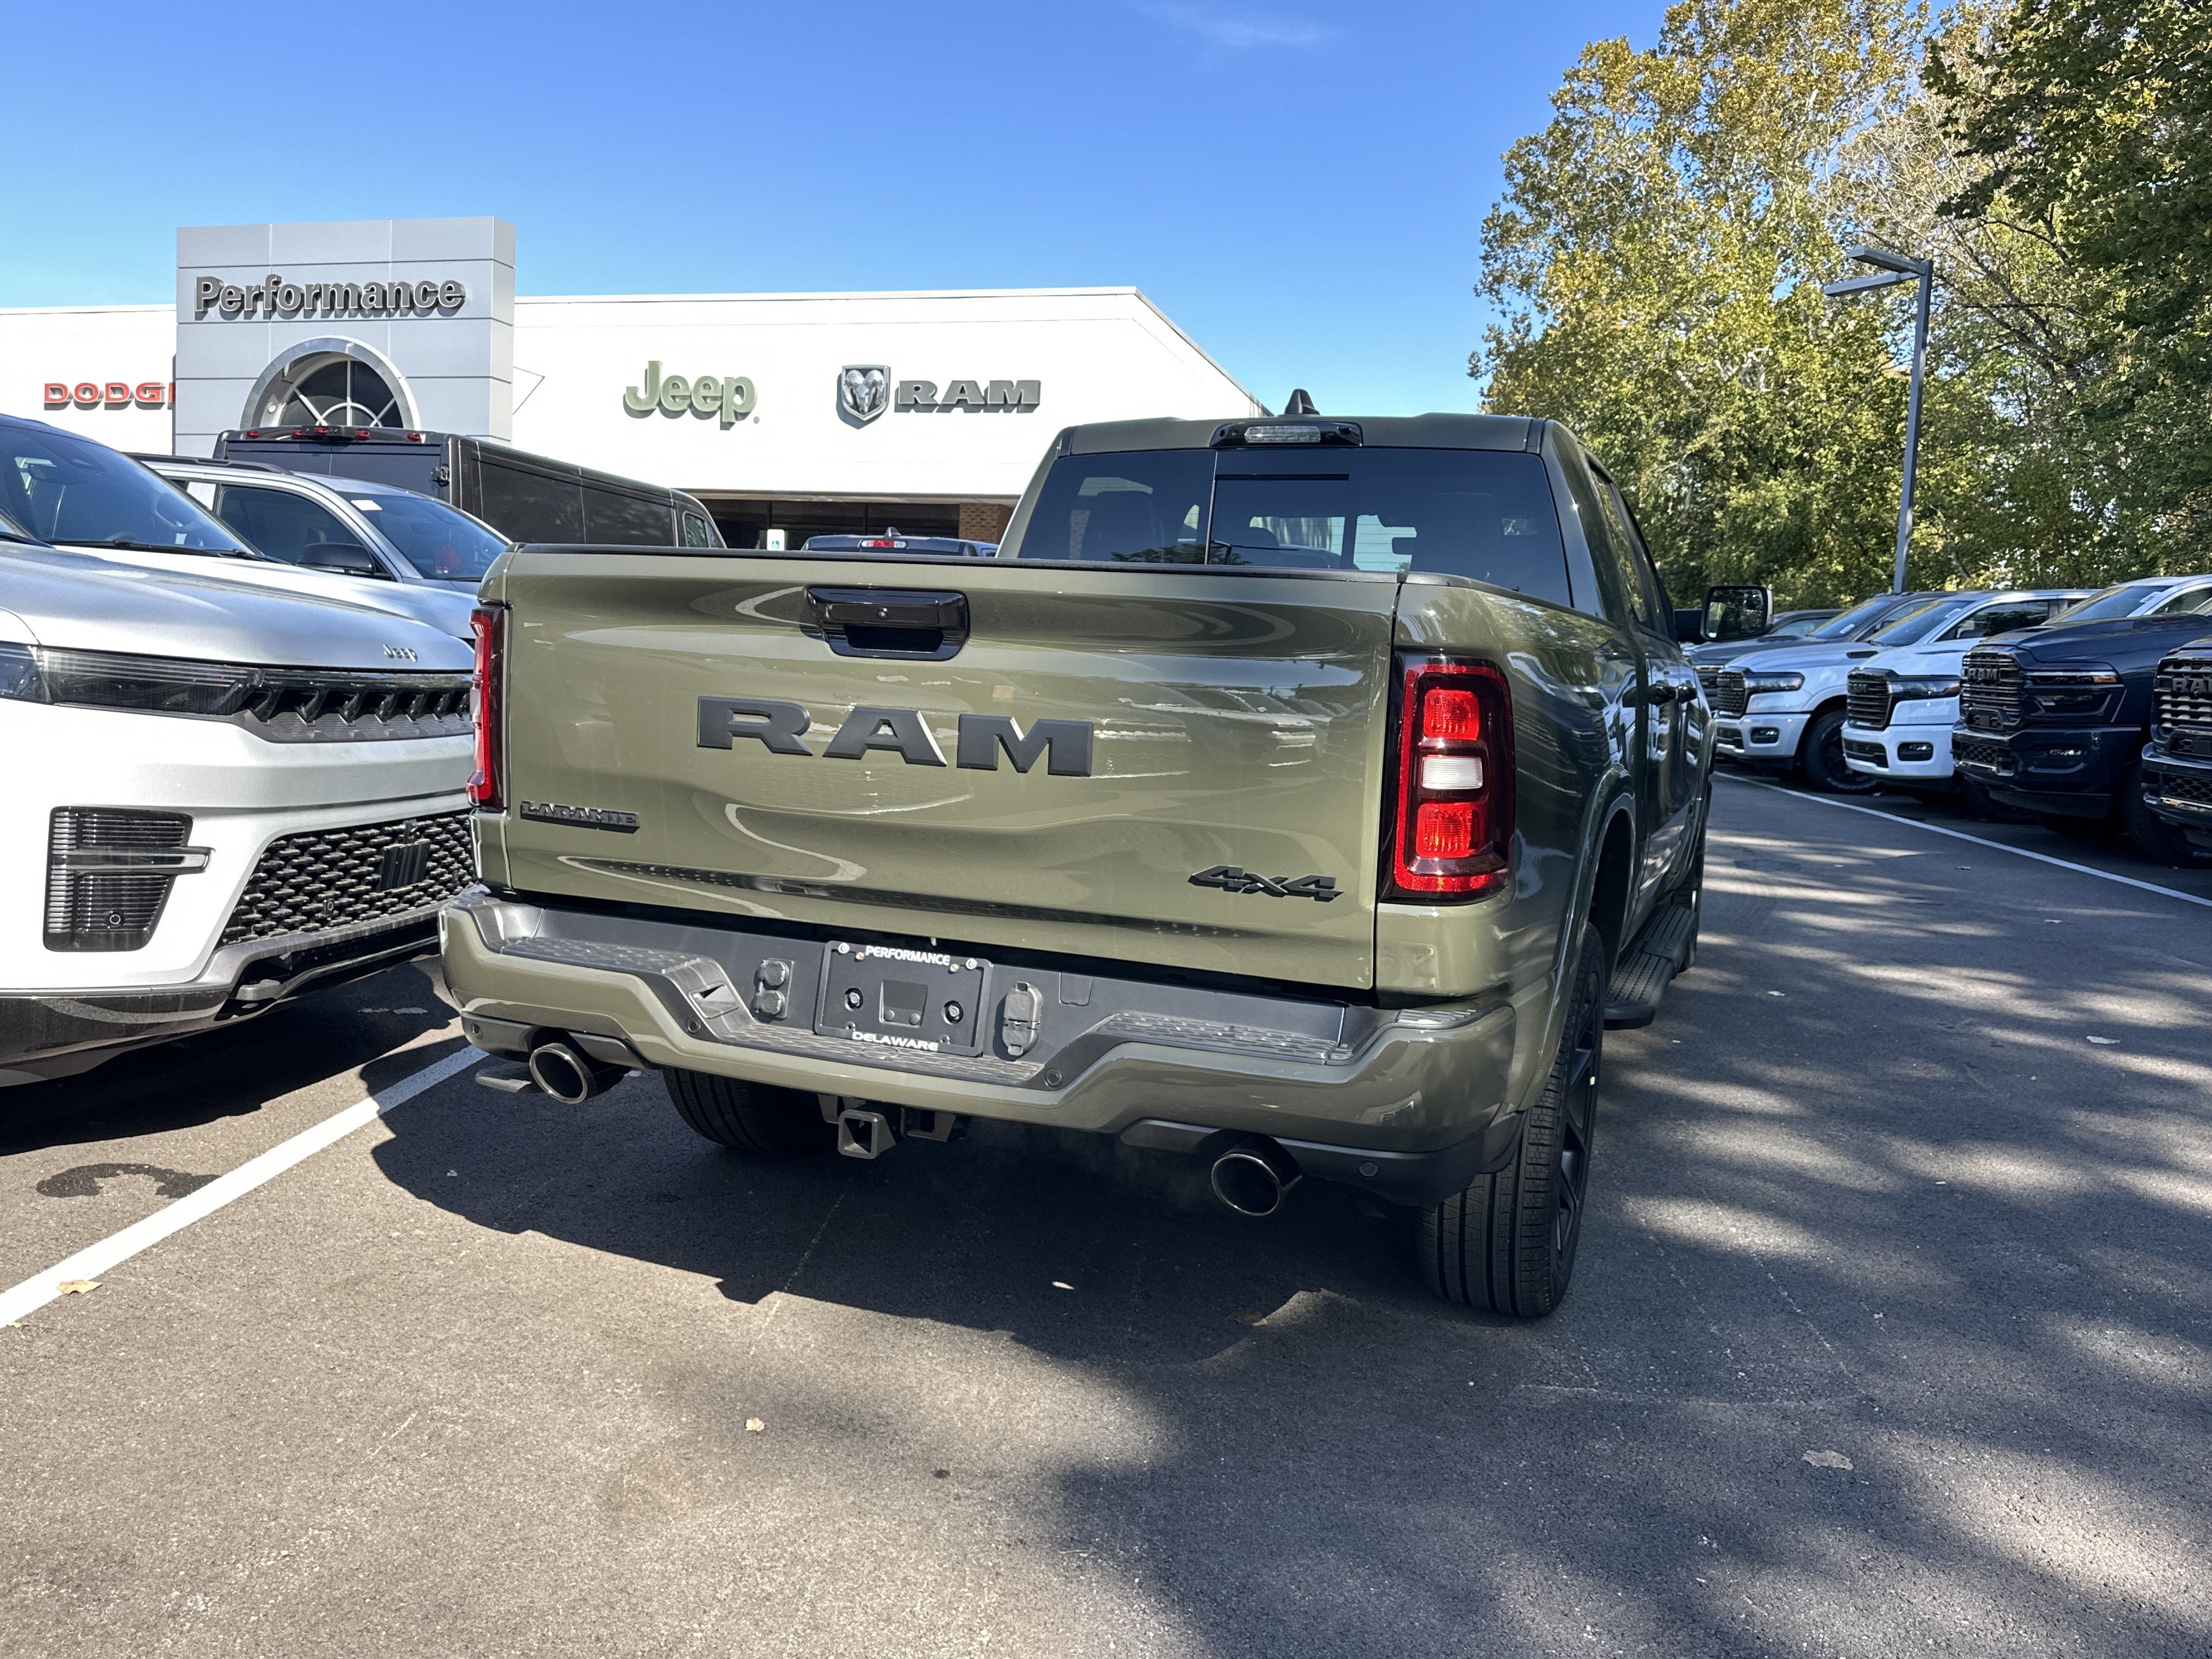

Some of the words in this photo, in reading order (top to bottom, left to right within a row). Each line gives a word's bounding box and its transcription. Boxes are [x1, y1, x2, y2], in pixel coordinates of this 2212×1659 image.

[194, 273, 466, 313] Performance
[44, 382, 176, 404] DODG
[624, 360, 757, 422] Jeep
[898, 380, 1041, 405] RAM
[383, 644, 419, 663] Jeep
[1967, 667, 1998, 681] RAM
[2172, 677, 2212, 693] RA
[696, 695, 1094, 777] RAM
[521, 799, 640, 830] LARAMIE
[865, 945, 951, 966] PERFORMANCE
[851, 1031, 939, 1052] DELAWARE
